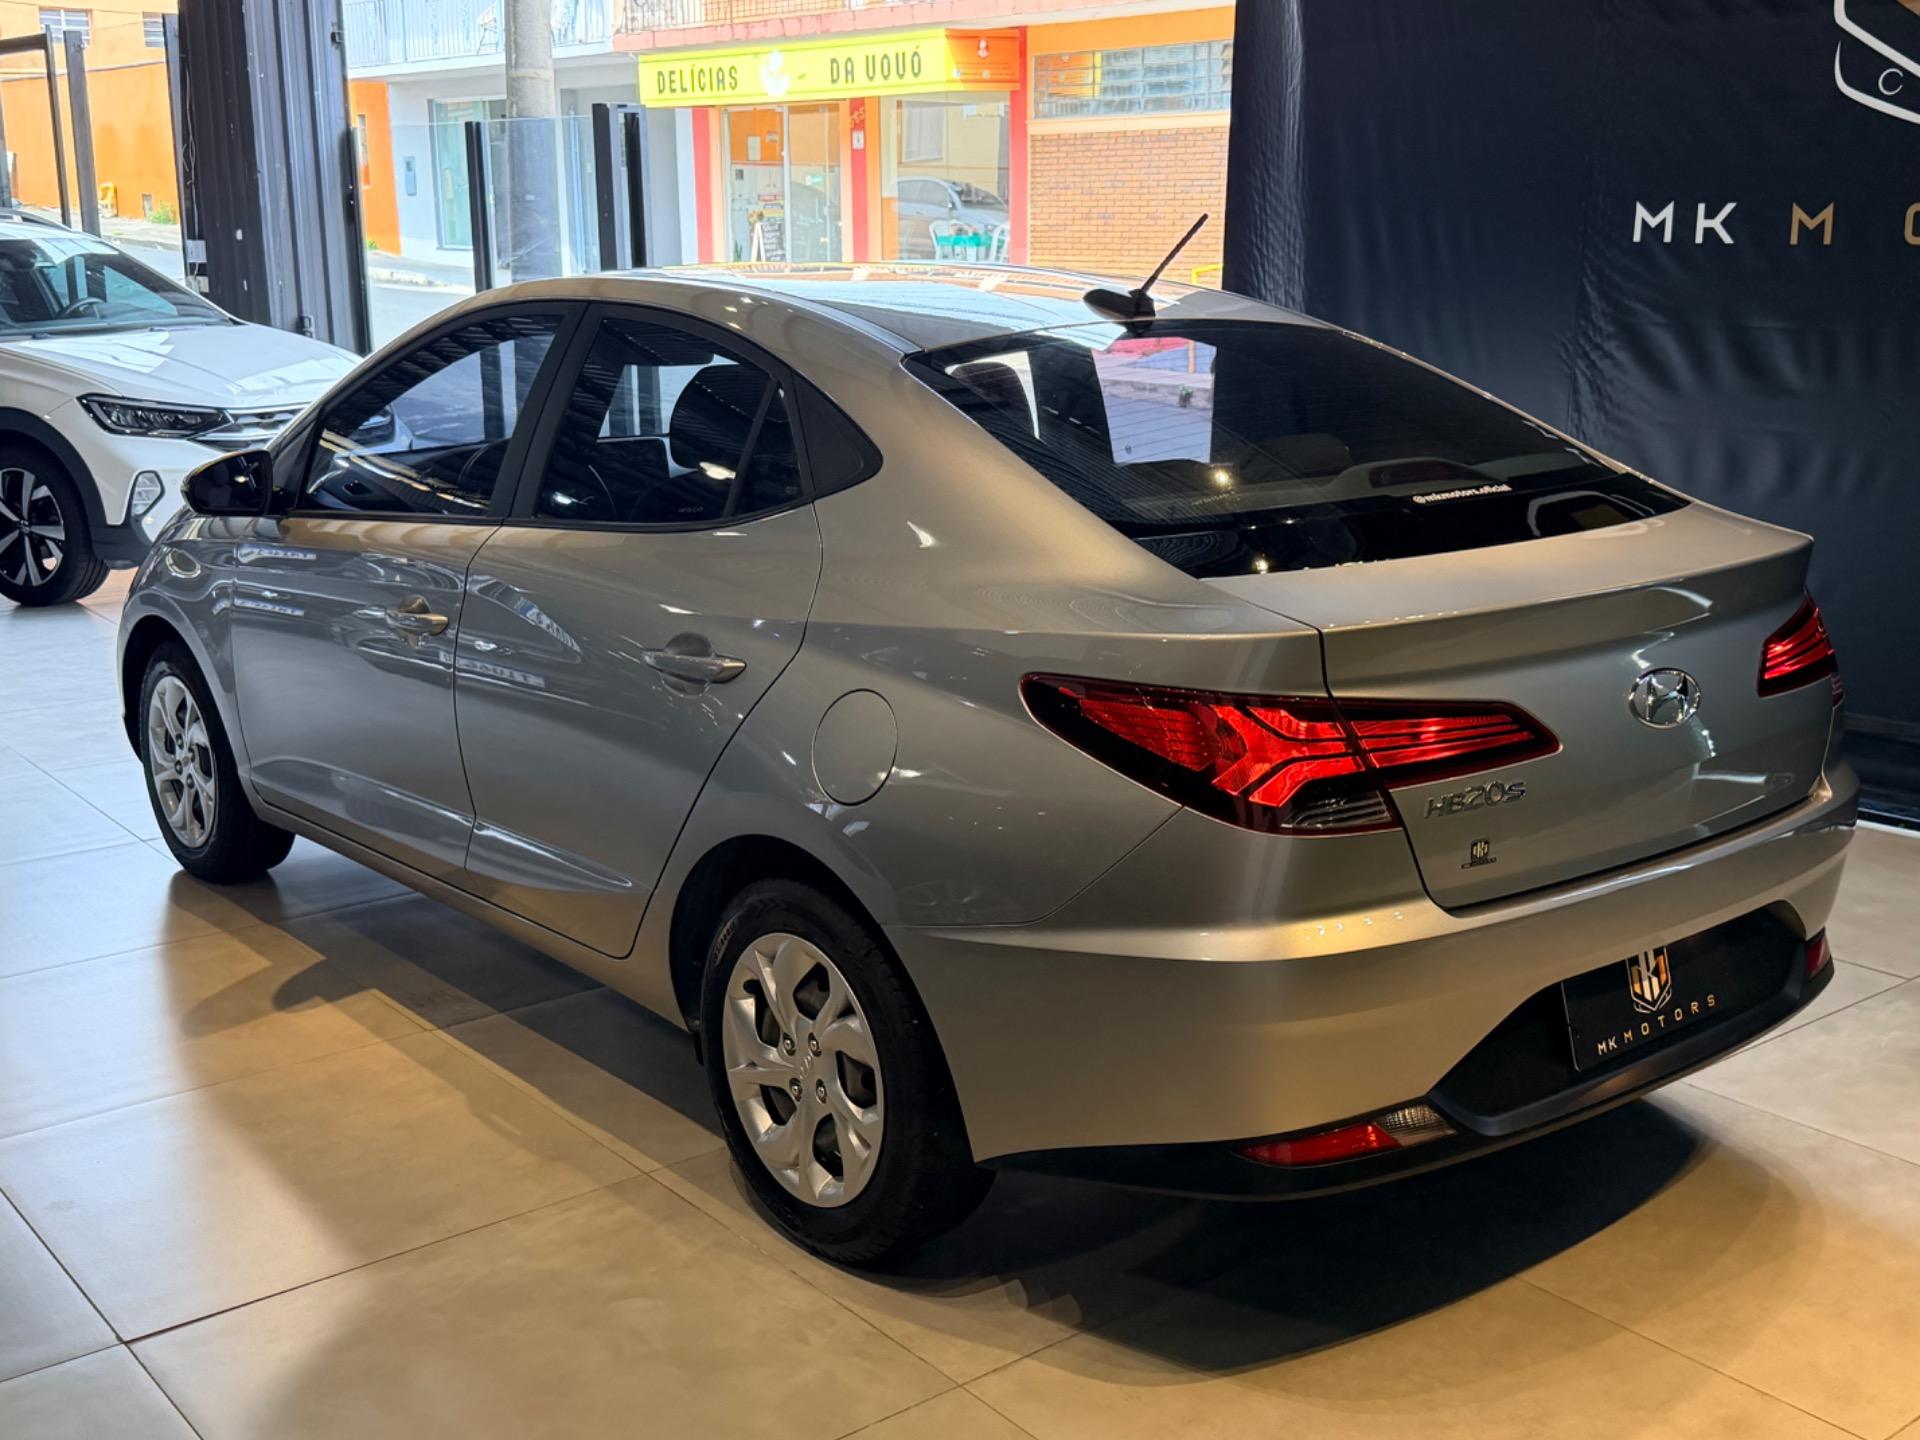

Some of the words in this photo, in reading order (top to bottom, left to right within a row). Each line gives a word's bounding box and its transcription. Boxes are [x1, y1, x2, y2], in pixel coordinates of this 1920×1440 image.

[657, 64, 738, 94] DELÍCIAS
[830, 57, 854, 84] DA
[1632, 200, 1738, 244] MK
[1597, 1036, 1618, 1055] MK
[1623, 994, 1716, 1044] MOTORS
